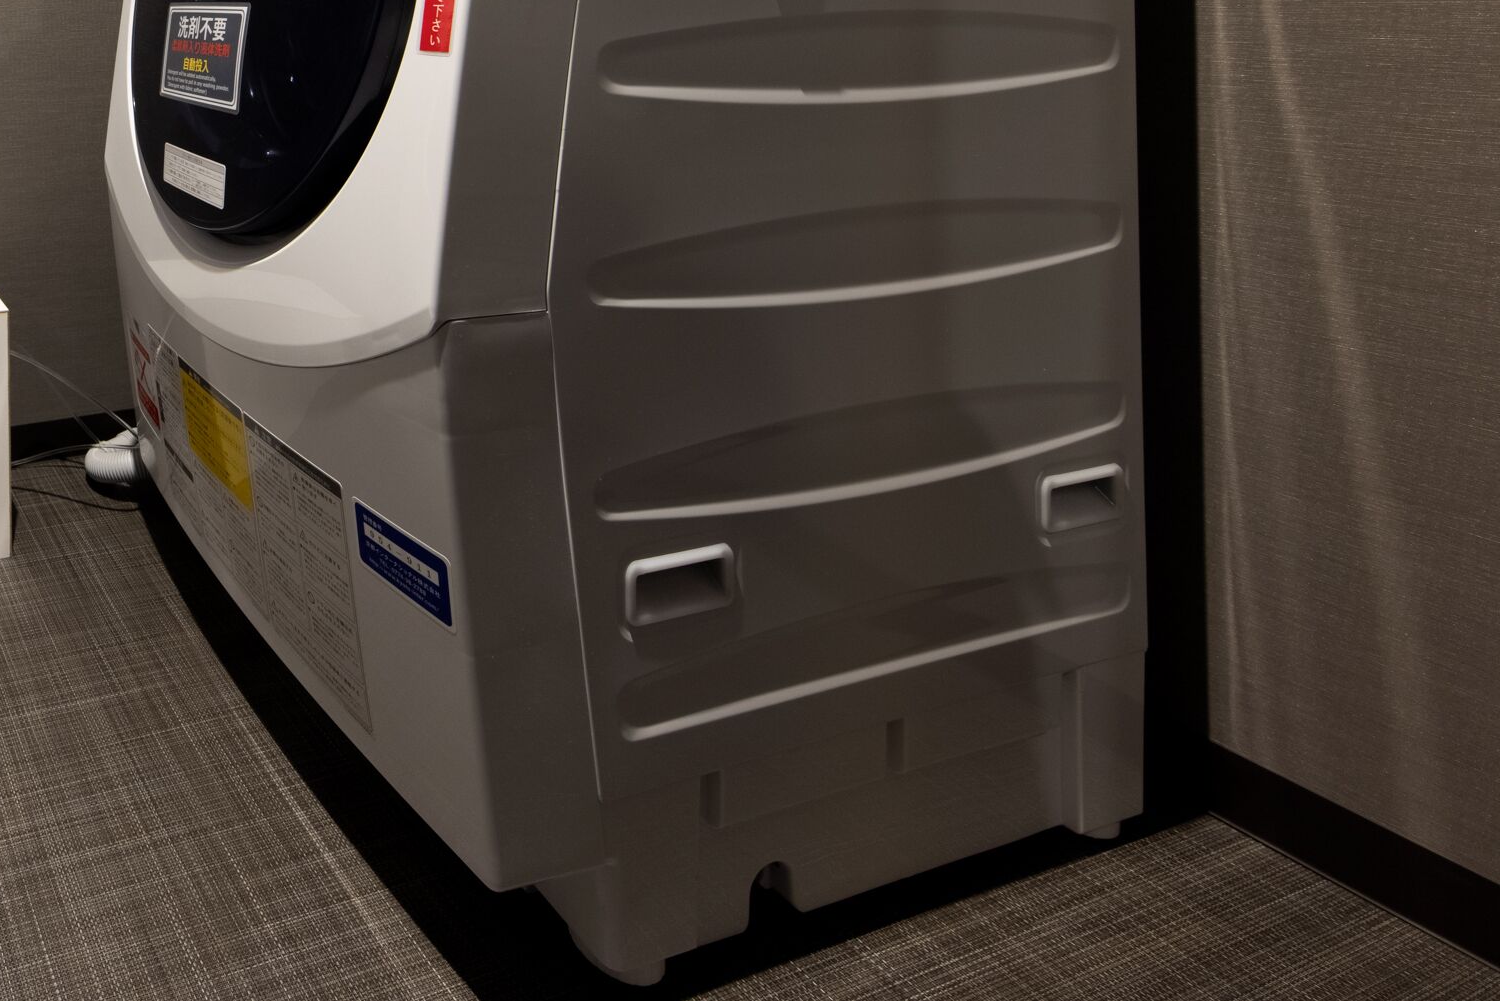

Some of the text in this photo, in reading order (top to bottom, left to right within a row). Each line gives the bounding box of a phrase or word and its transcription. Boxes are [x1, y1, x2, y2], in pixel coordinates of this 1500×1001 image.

[177, 15, 227, 42] 洗剤不要
[182, 56, 210, 74] 自動投入
